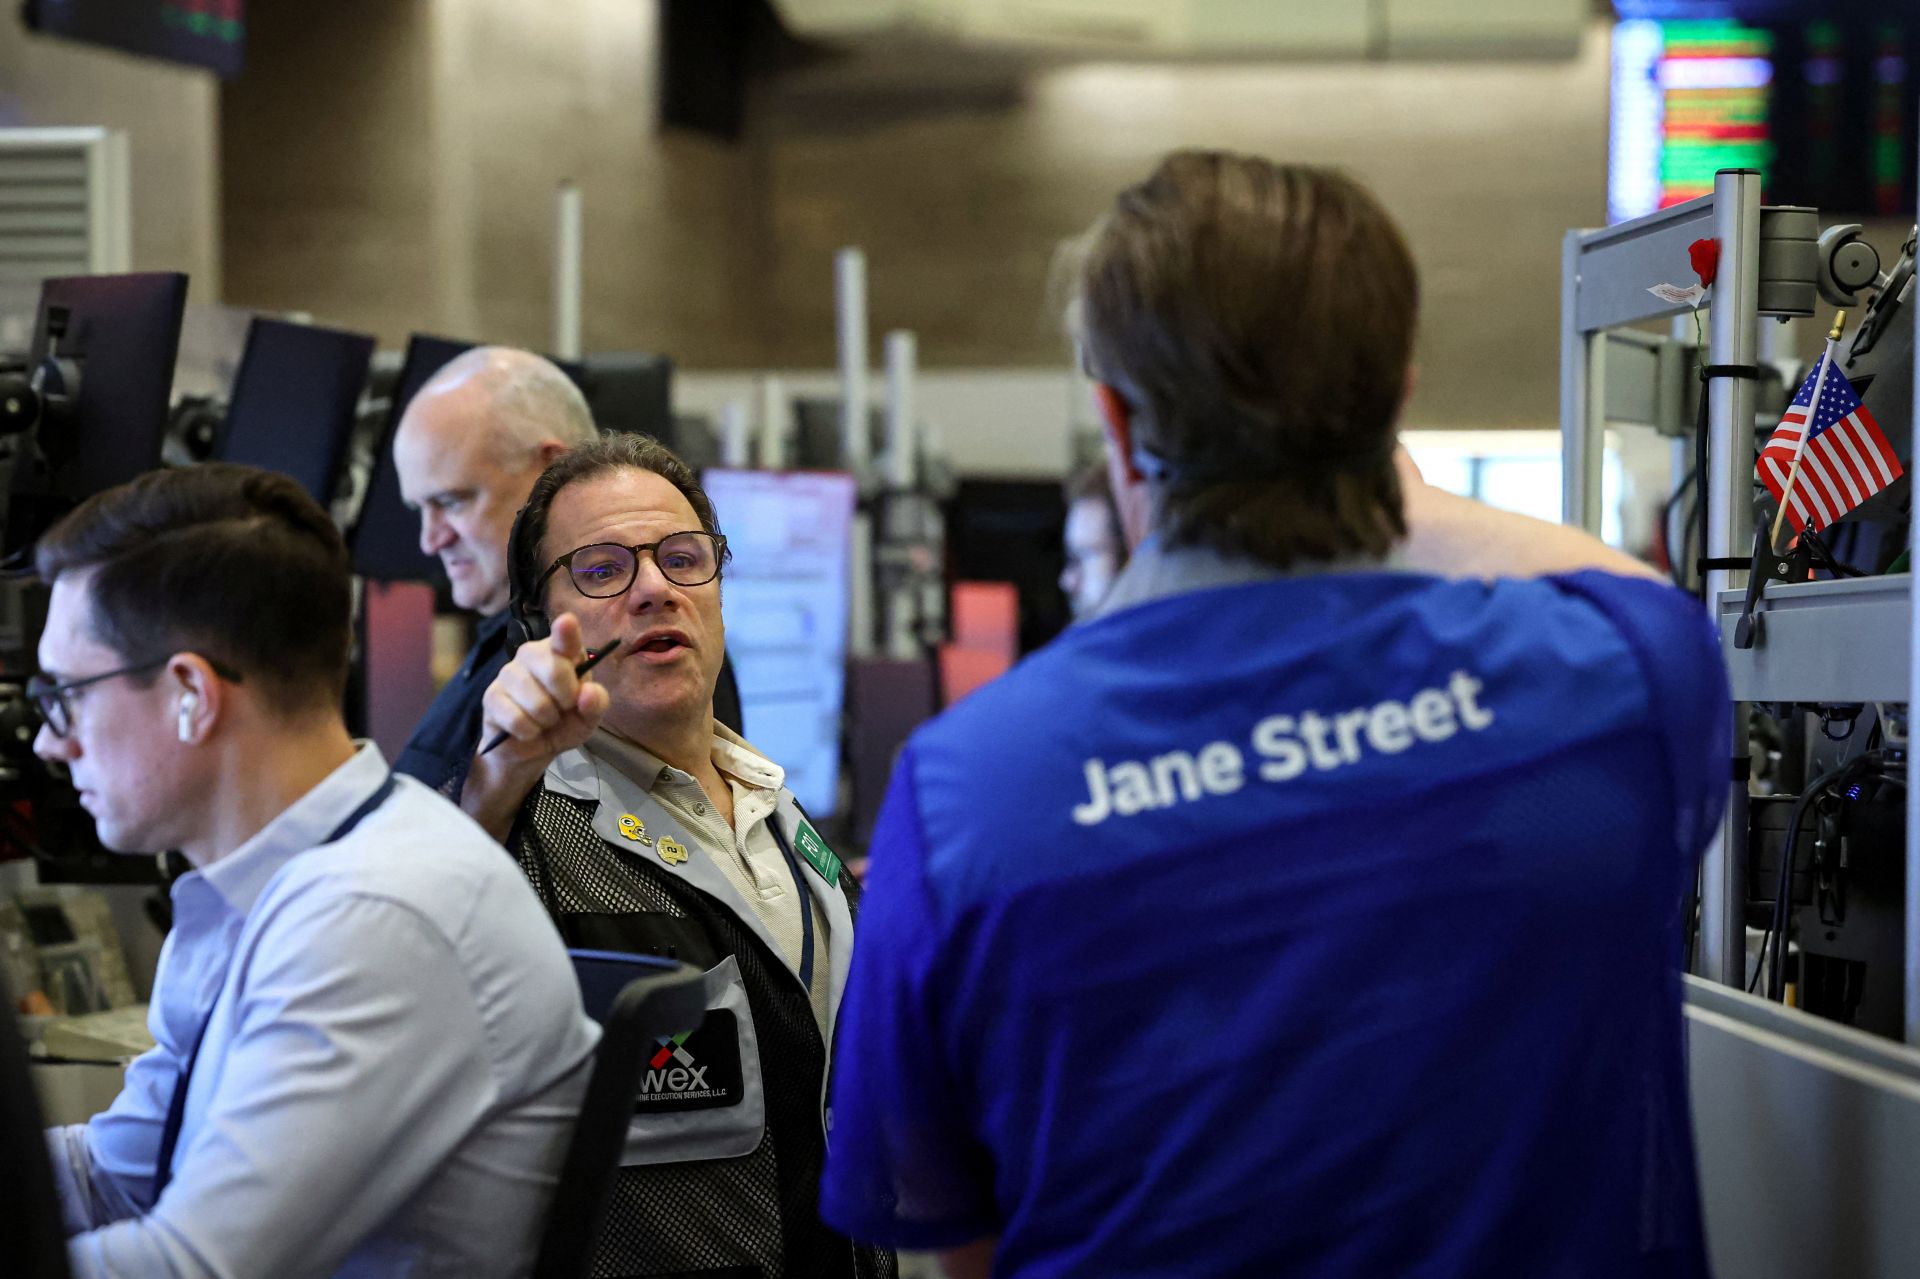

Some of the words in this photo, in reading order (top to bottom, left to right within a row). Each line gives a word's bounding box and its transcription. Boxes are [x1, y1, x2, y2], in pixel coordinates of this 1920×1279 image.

[1073, 741, 1244, 825] Jane
[1252, 671, 1493, 781] Street
[650, 1092, 683, 1101] EXECUTION
